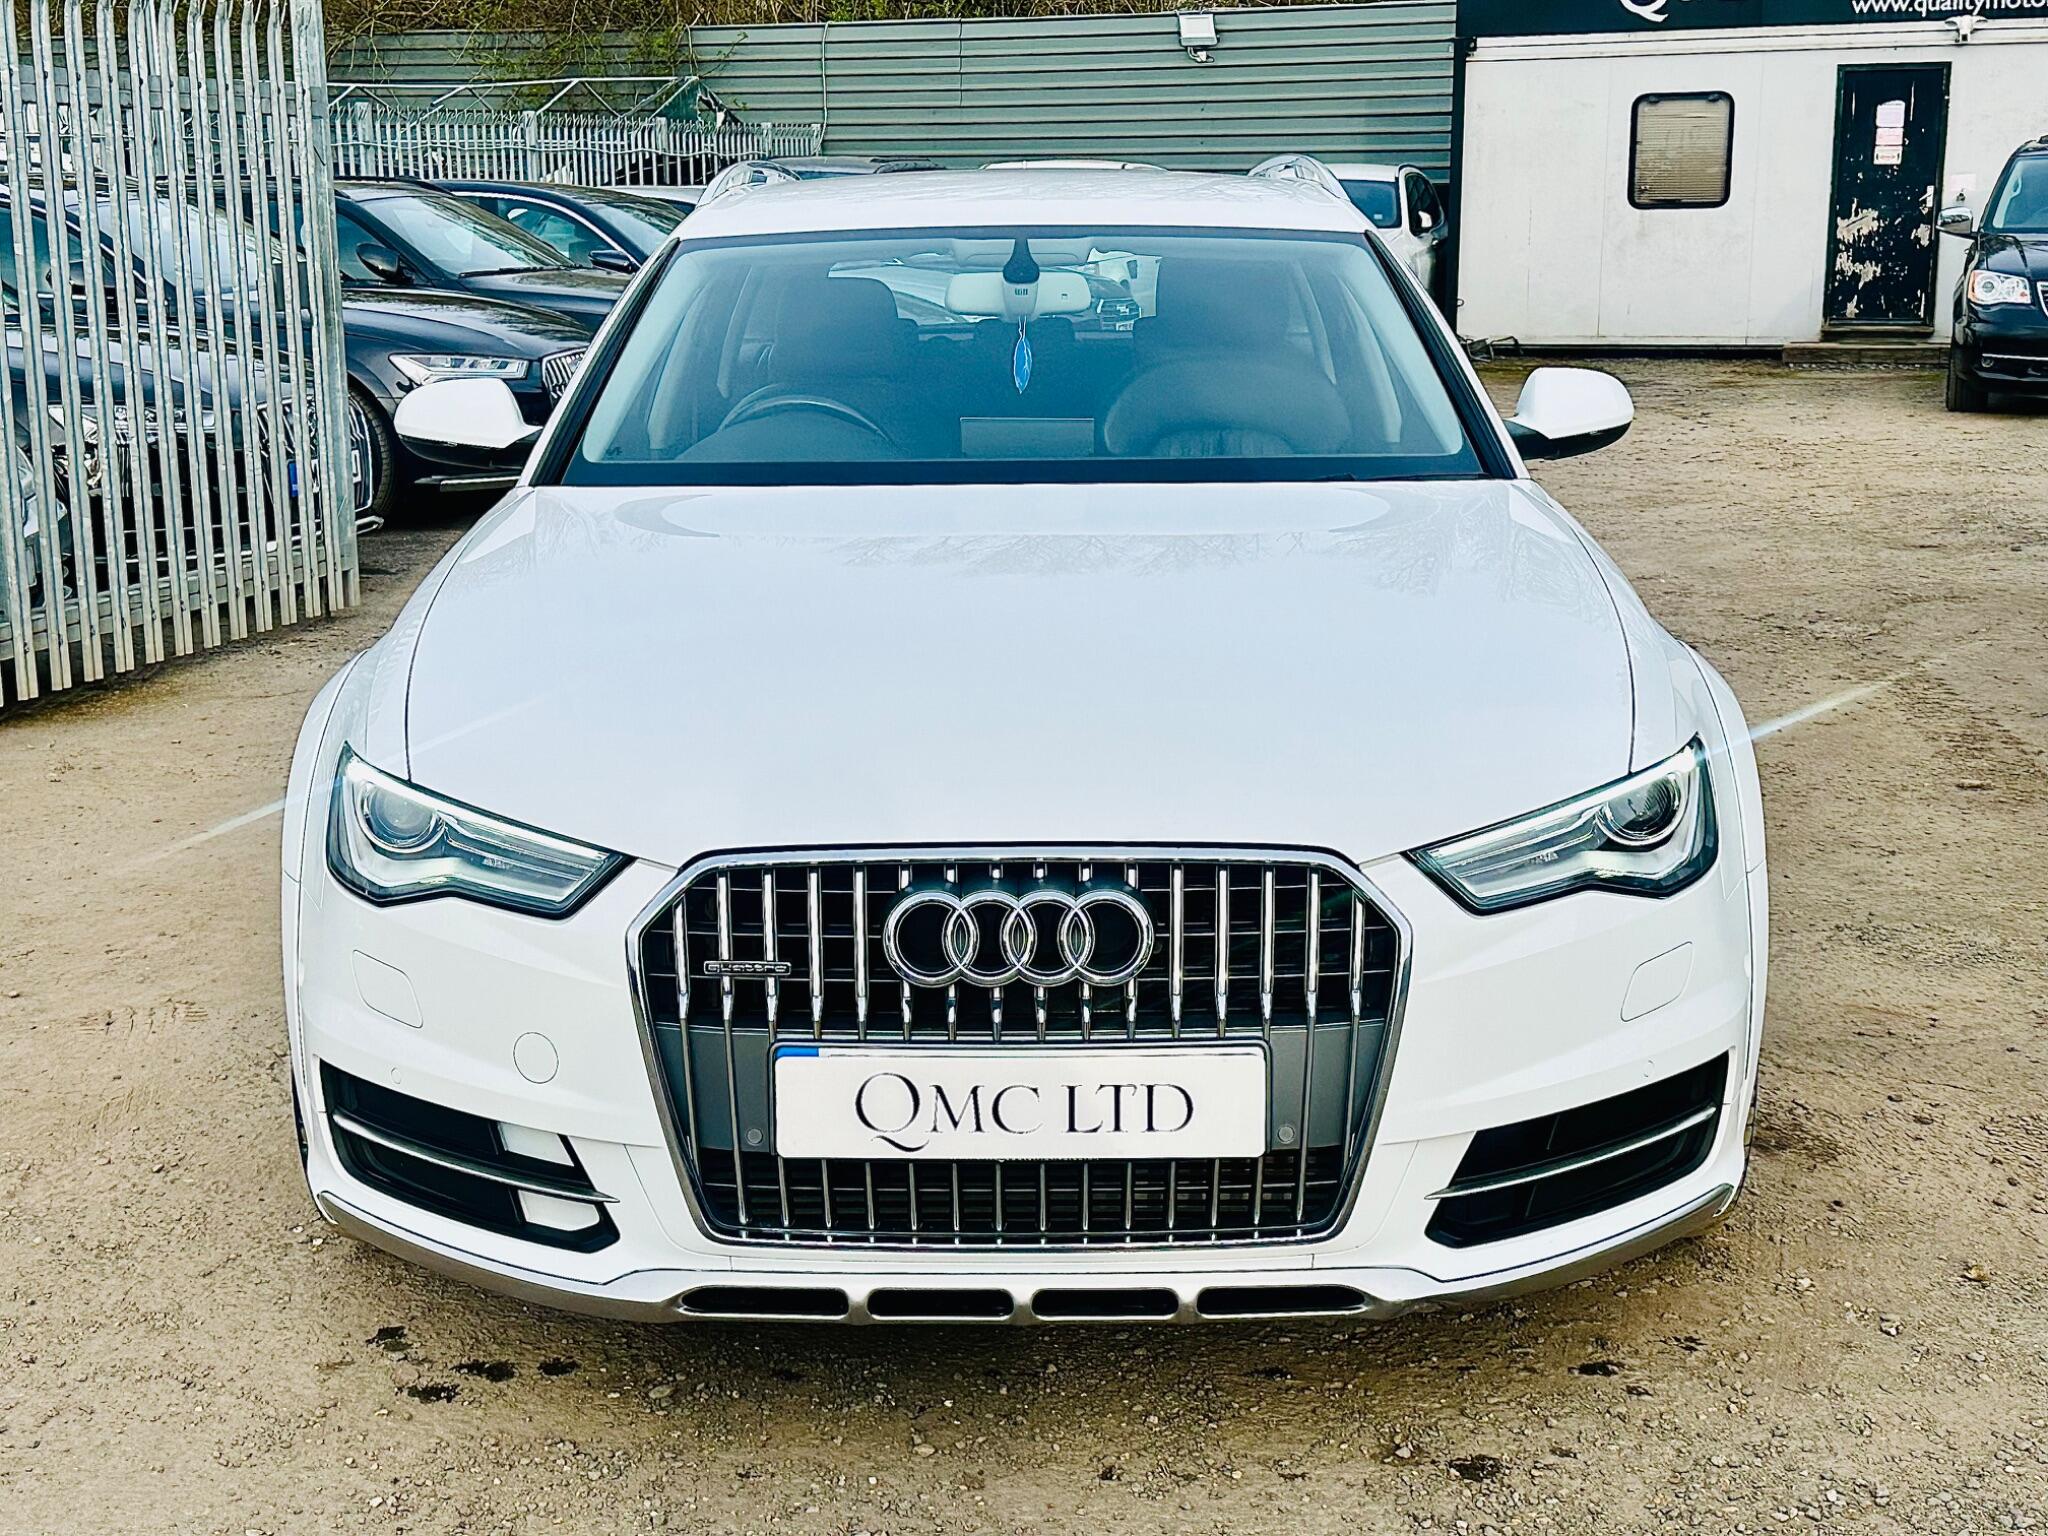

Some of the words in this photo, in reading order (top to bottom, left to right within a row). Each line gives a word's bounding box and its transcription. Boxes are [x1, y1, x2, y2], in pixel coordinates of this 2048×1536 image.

[1852, 0, 2048, 17] www.qualitymoto
[855, 1072, 1045, 1153] QMC
[1061, 1083, 1194, 1133] LTD
